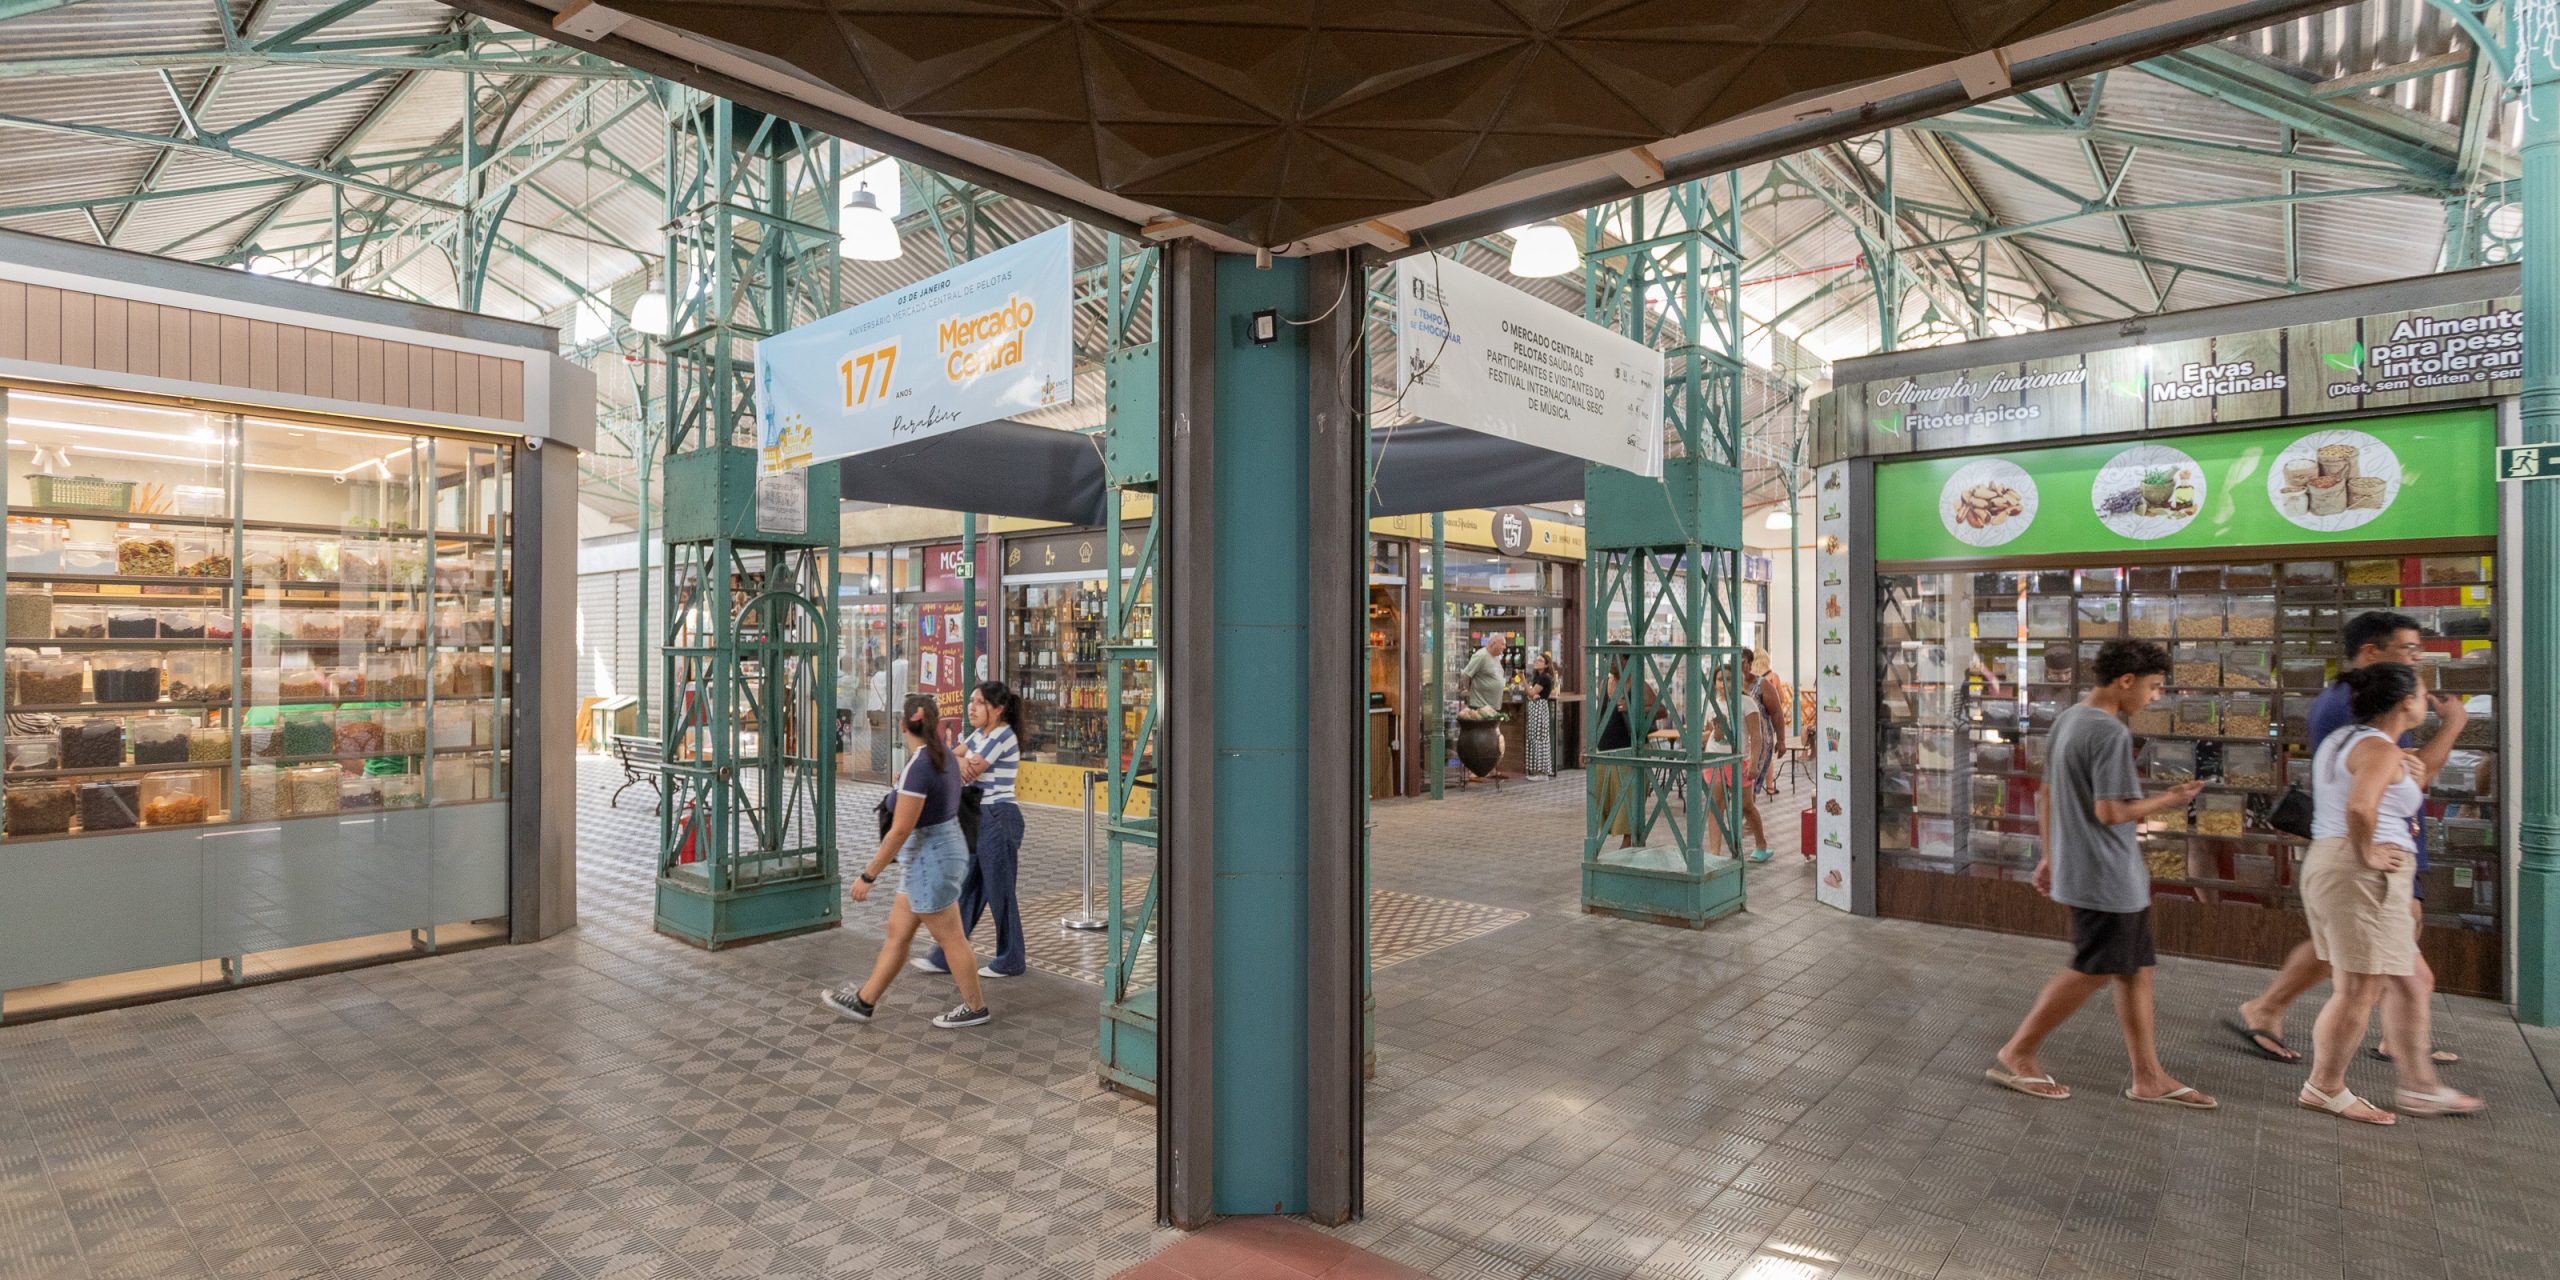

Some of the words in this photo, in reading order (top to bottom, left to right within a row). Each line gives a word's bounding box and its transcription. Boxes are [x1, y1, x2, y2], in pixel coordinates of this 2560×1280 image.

[893, 302, 927, 321] MERCADO
[928, 291, 962, 308] CENTRAL
[963, 284, 974, 296] DE
[976, 271, 1013, 290] PELOTAS
[897, 295, 907, 306] 03
[908, 291, 919, 302] DE
[919, 279, 951, 298] JANEIRO
[939, 296, 1033, 353] Mercado
[1419, 307, 1443, 325] TEMPO
[947, 329, 1023, 381] Central
[1501, 320, 1509, 333] O
[1510, 322, 1550, 349] MERCADO
[1551, 340, 1584, 362] CENTRAL
[1584, 352, 1594, 366] DE
[1513, 341, 1548, 365] PELOTAS
[1548, 354, 1573, 375] SAÚDA
[1573, 364, 1584, 378] OS
[2371, 341, 2438, 366] para
[2447, 331, 2523, 357] pess
[841, 345, 897, 408] 177
[1486, 349, 1548, 381] PARTICIPANTES
[1548, 371, 1554, 383] E
[1554, 373, 1594, 397] VISITANTES
[1594, 387, 1605, 401] DO
[2182, 361, 2254, 382] Ervas
[2383, 349, 2523, 378] intoleran
[895, 388, 912, 399] ANOS
[1488, 367, 1526, 391] FESTIVAL
[1526, 380, 1586, 410] INTERNACIONAL
[1586, 400, 1604, 416] SESC
[1876, 375, 1978, 407] Alimentos
[1975, 362, 2088, 401] funcionais
[2152, 371, 2287, 402] Medicinais
[2328, 382, 2373, 398] (Diet,
[2376, 378, 2410, 391] sem
[2413, 371, 2471, 388] Glúten
[2475, 373, 2486, 382] e
[2490, 367, 2523, 380] sem
[1528, 397, 1539, 411] DE
[1905, 404, 2040, 431] Fitoterápicos
